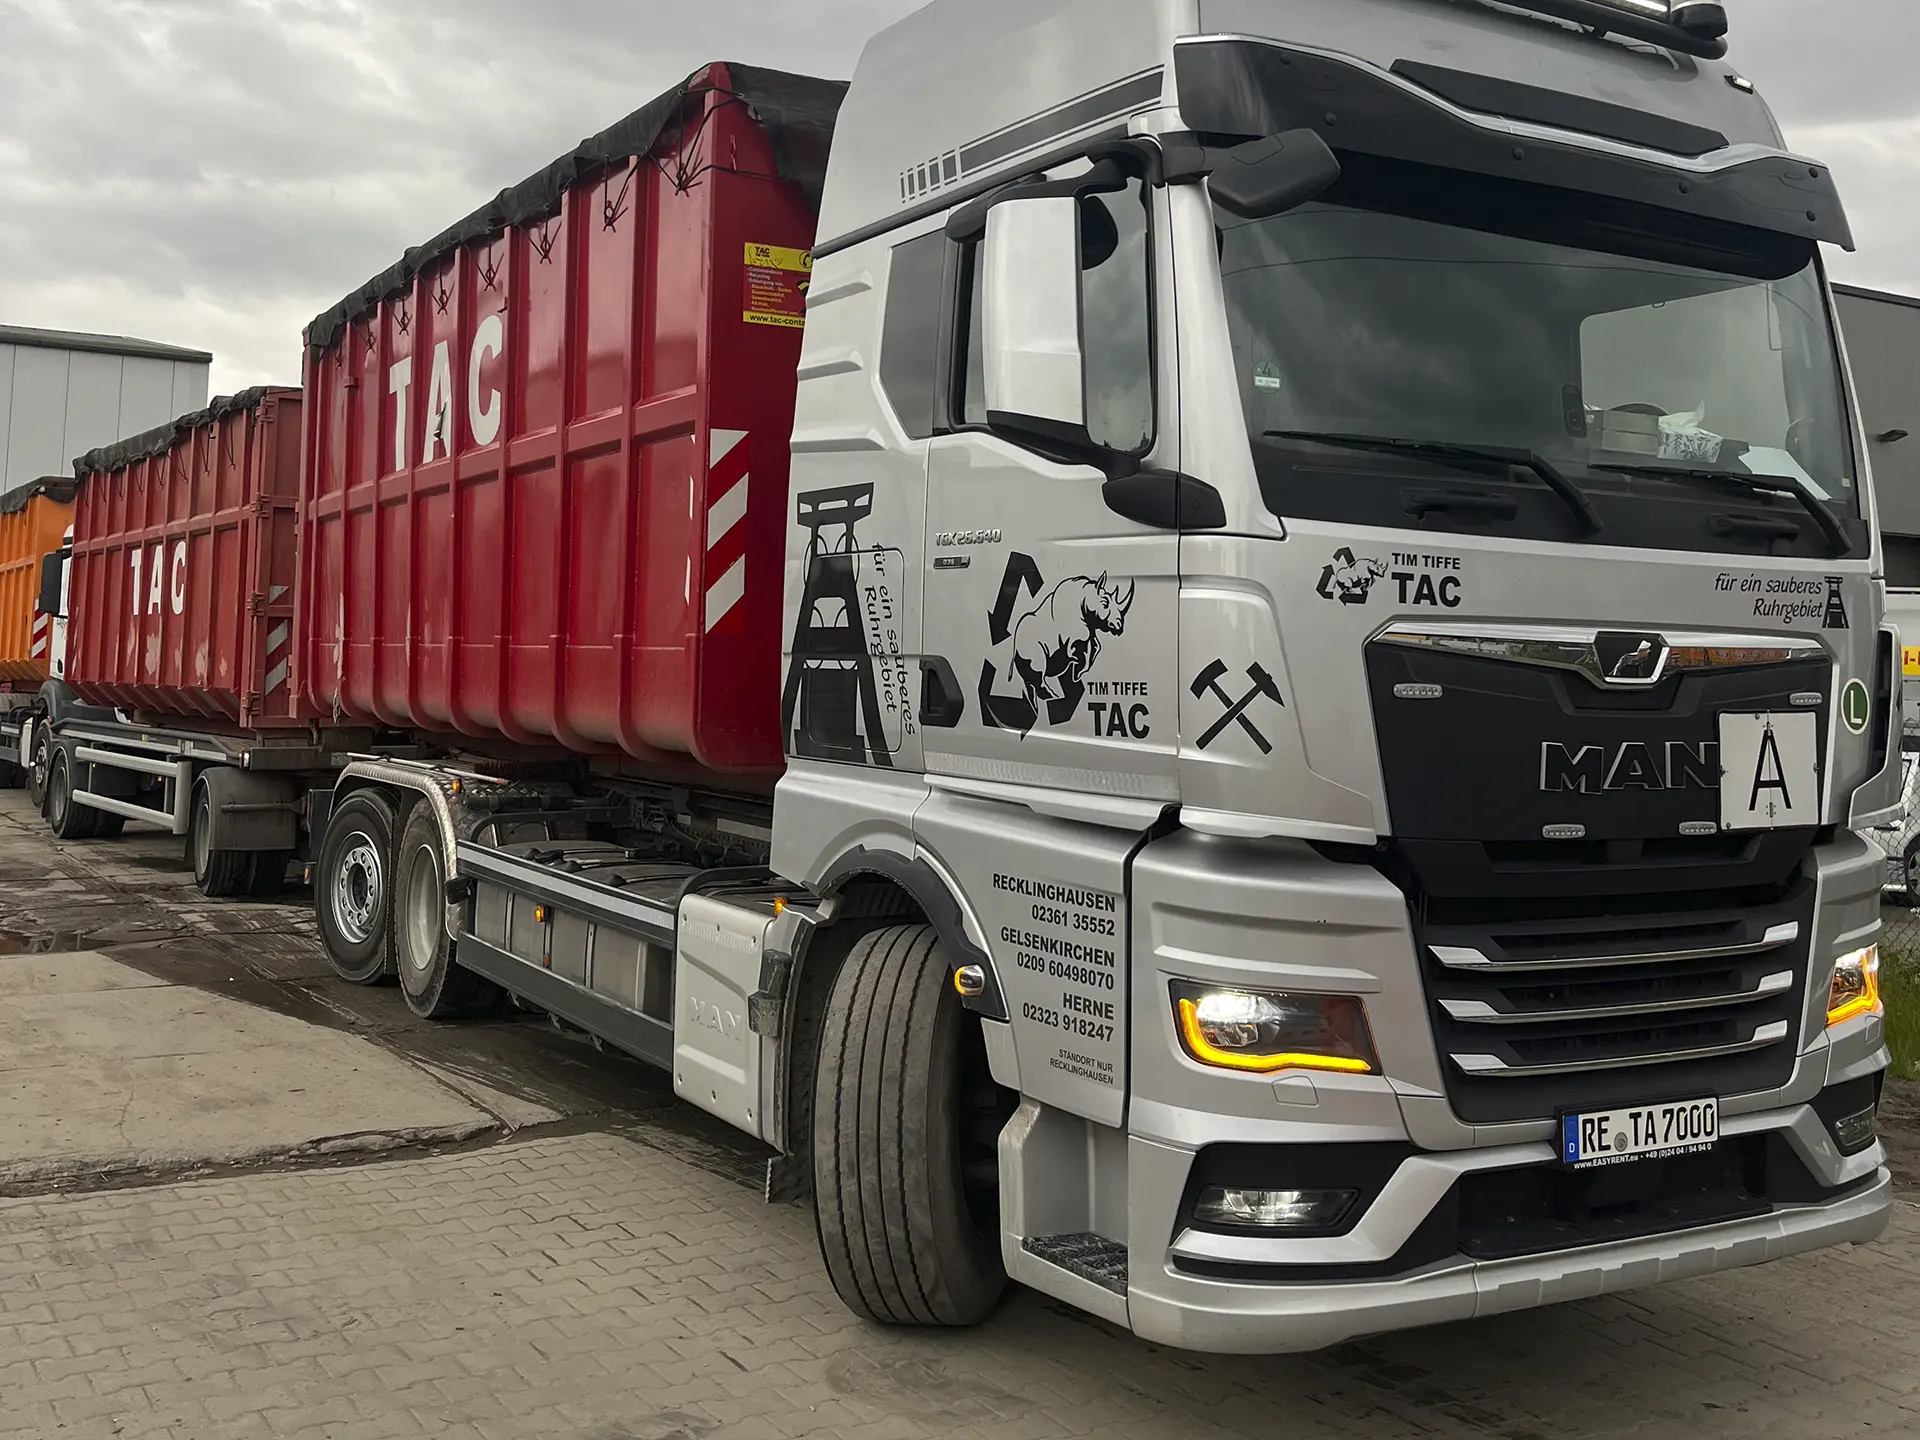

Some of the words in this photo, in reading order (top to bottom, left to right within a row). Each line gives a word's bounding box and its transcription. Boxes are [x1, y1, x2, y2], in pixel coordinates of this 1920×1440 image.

[755, 246, 770, 255] TAC
[389, 314, 503, 471] TAC
[935, 532, 957, 546] TGX
[131, 541, 187, 615] TAC
[1392, 552, 1417, 567] TIM
[1422, 555, 1461, 570] TIFFE
[1391, 572, 1461, 608] TAC
[1714, 573, 1738, 591] für
[1740, 573, 1762, 592] ein
[1765, 576, 1822, 595] sauberes
[1753, 598, 1824, 624] Ruhrgebiet
[864, 585, 897, 714] Ruhrgebiet
[872, 542, 886, 577] für
[879, 585, 893, 620] ein
[887, 629, 915, 735] sauberes
[1087, 682, 1109, 695] TIM
[1112, 682, 1148, 696] TIFFE
[1850, 689, 1863, 724] L
[1088, 702, 1150, 739] TAC
[1539, 741, 1719, 795] MAN
[1748, 728, 1792, 811] A
[993, 873, 1115, 913] RECKLINGHAUSEN
[1032, 904, 1068, 927] 02361
[1073, 913, 1115, 936] 35552
[1001, 926, 1115, 967] GELSENKIRCHEN
[1017, 952, 1045, 973] 0209
[1049, 960, 1114, 990] 60498070
[690, 996, 742, 1041] MAN
[1023, 1002, 1059, 1028] 02323
[1063, 1014, 1114, 1042] 918247
[1063, 993, 1114, 1020] HERNE
[1050, 1058, 1114, 1085] RECKLINGHAUSEN
[1058, 1049, 1095, 1068] STANDORT
[1097, 1060, 1114, 1073] NUR
[1582, 1116, 1611, 1153] RE
[1629, 1111, 1657, 1146] TA
[1662, 1103, 1715, 1143] 7000
[1569, 1142, 1575, 1153] D
[1573, 1154, 1639, 1170] www.EASYRENT.eu
[1645, 1149, 1657, 1159] +49
